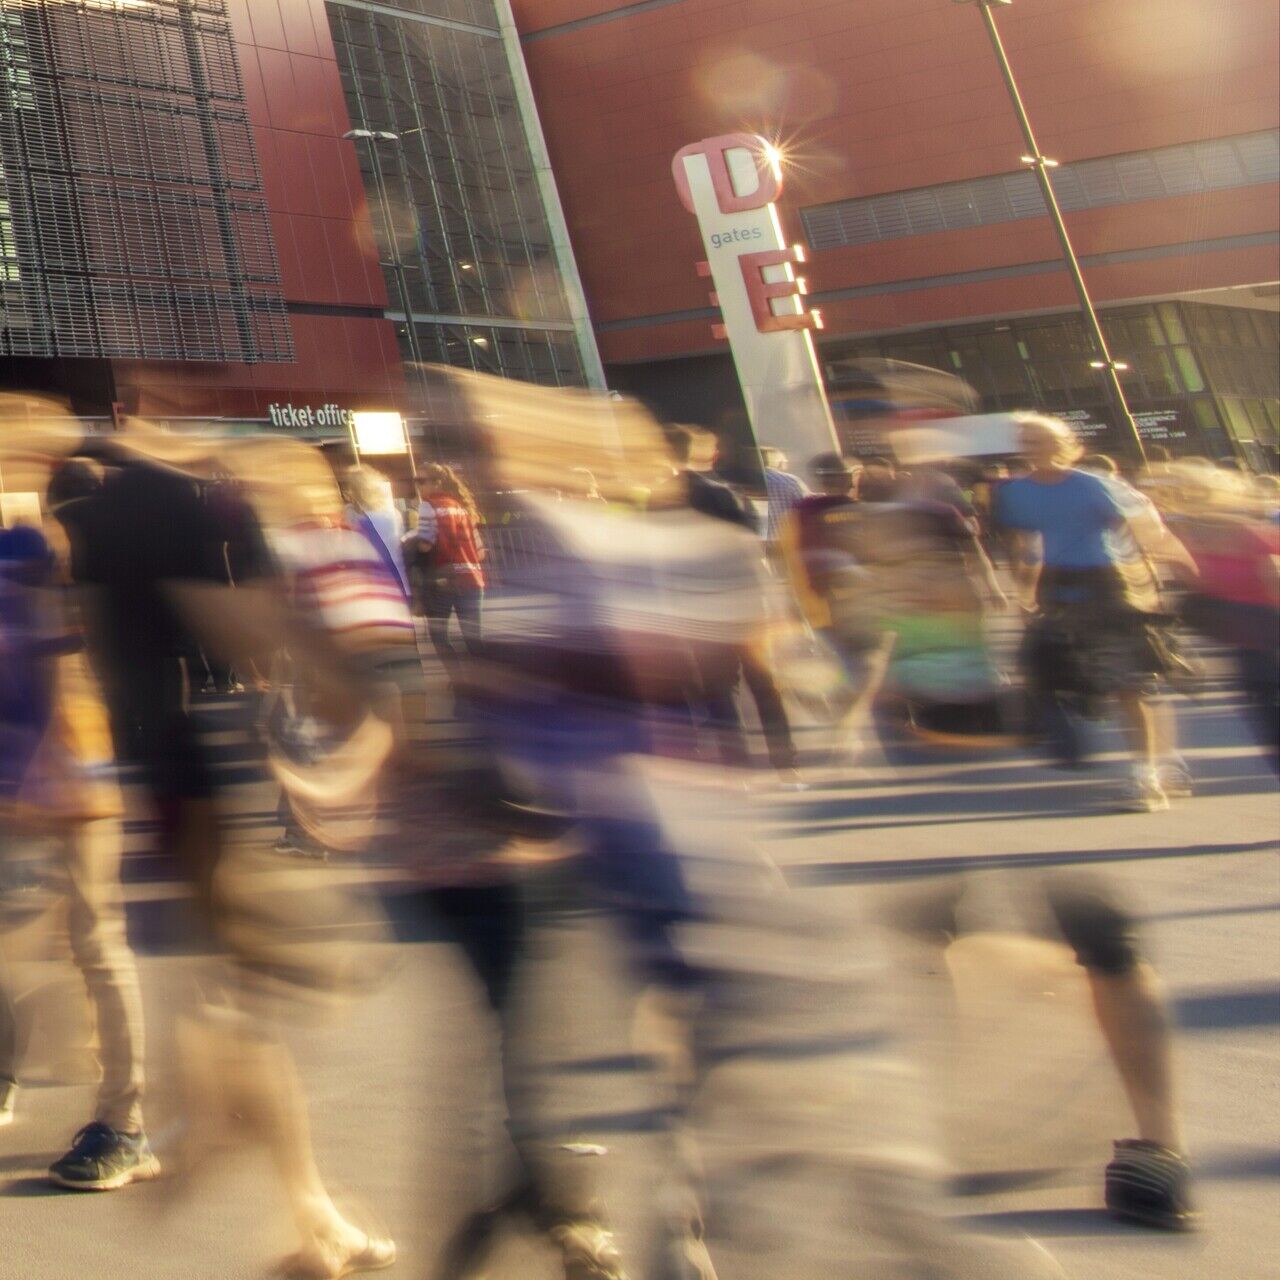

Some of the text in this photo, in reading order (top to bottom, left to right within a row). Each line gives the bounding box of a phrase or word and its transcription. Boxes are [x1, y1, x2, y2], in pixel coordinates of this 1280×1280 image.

[711, 225, 762, 248] gates
[738, 246, 818, 333] E
[269, 403, 314, 427] ticket
